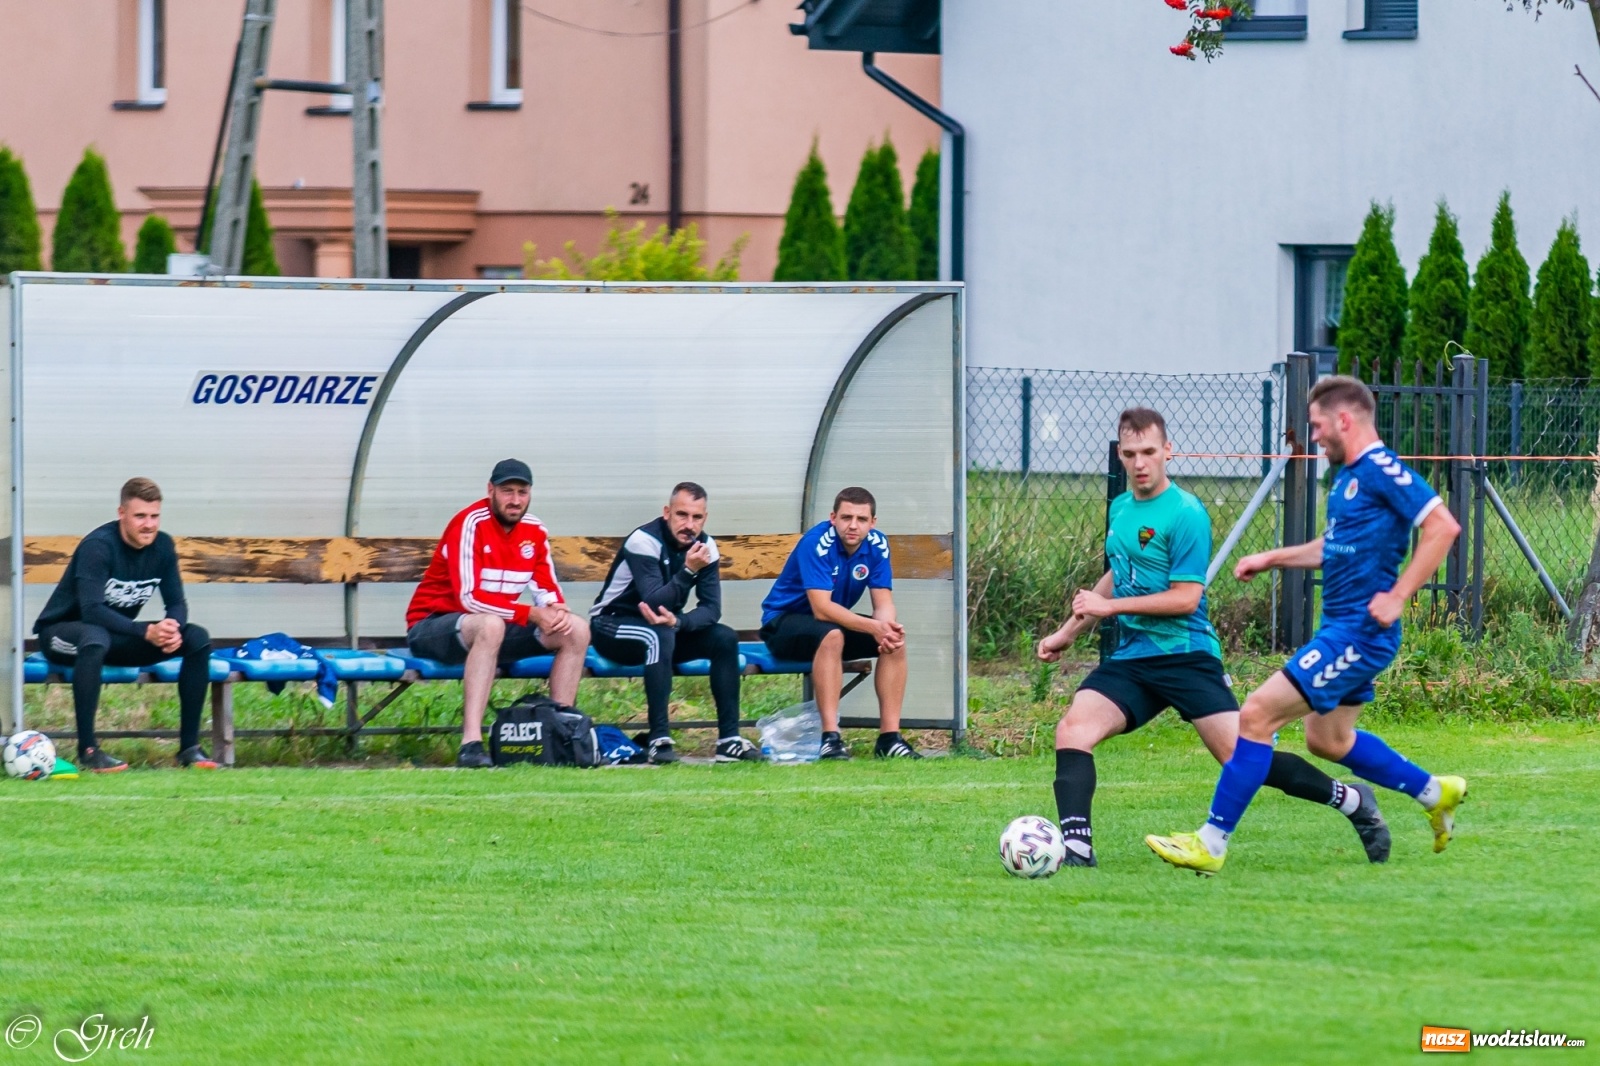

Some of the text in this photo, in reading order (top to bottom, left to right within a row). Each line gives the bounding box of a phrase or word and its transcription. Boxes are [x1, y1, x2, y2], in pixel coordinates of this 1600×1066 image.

[192, 374, 379, 405] GOSPDARZE
[1298, 649, 1322, 670] 8
[499, 722, 543, 742] SELECT
